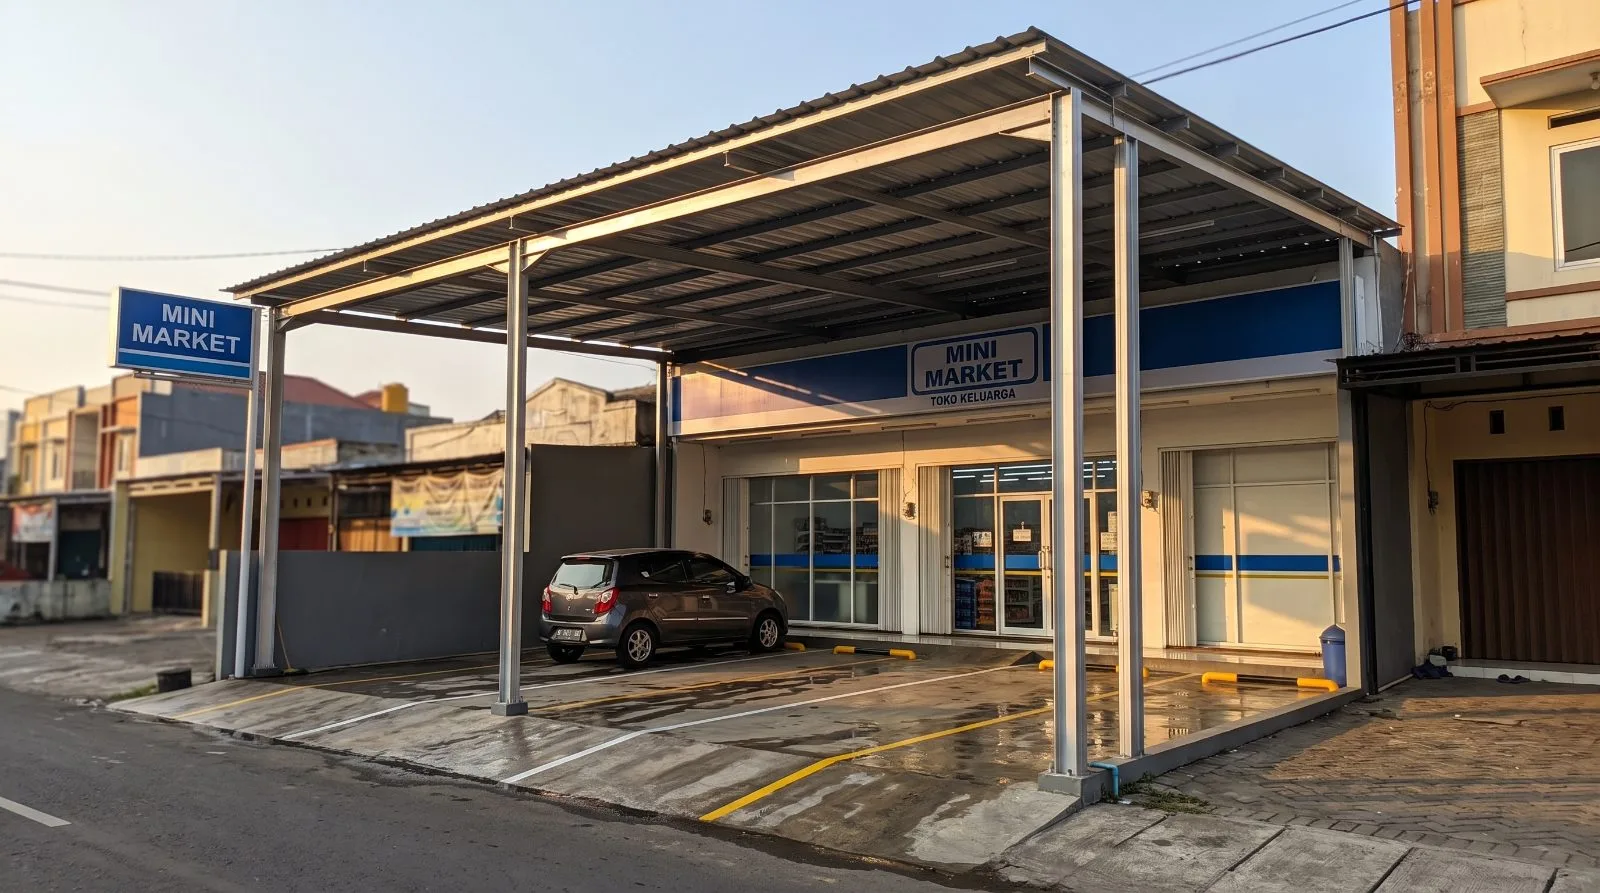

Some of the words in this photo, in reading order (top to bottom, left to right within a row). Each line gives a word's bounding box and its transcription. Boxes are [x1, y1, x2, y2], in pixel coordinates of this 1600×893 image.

[162, 303, 215, 328] MINI
[132, 323, 241, 354] MARKET
[946, 340, 997, 364] MINI
[925, 359, 1023, 389] MARKET
[930, 394, 957, 406] TOKO
[960, 388, 1016, 404] KELUARGA
